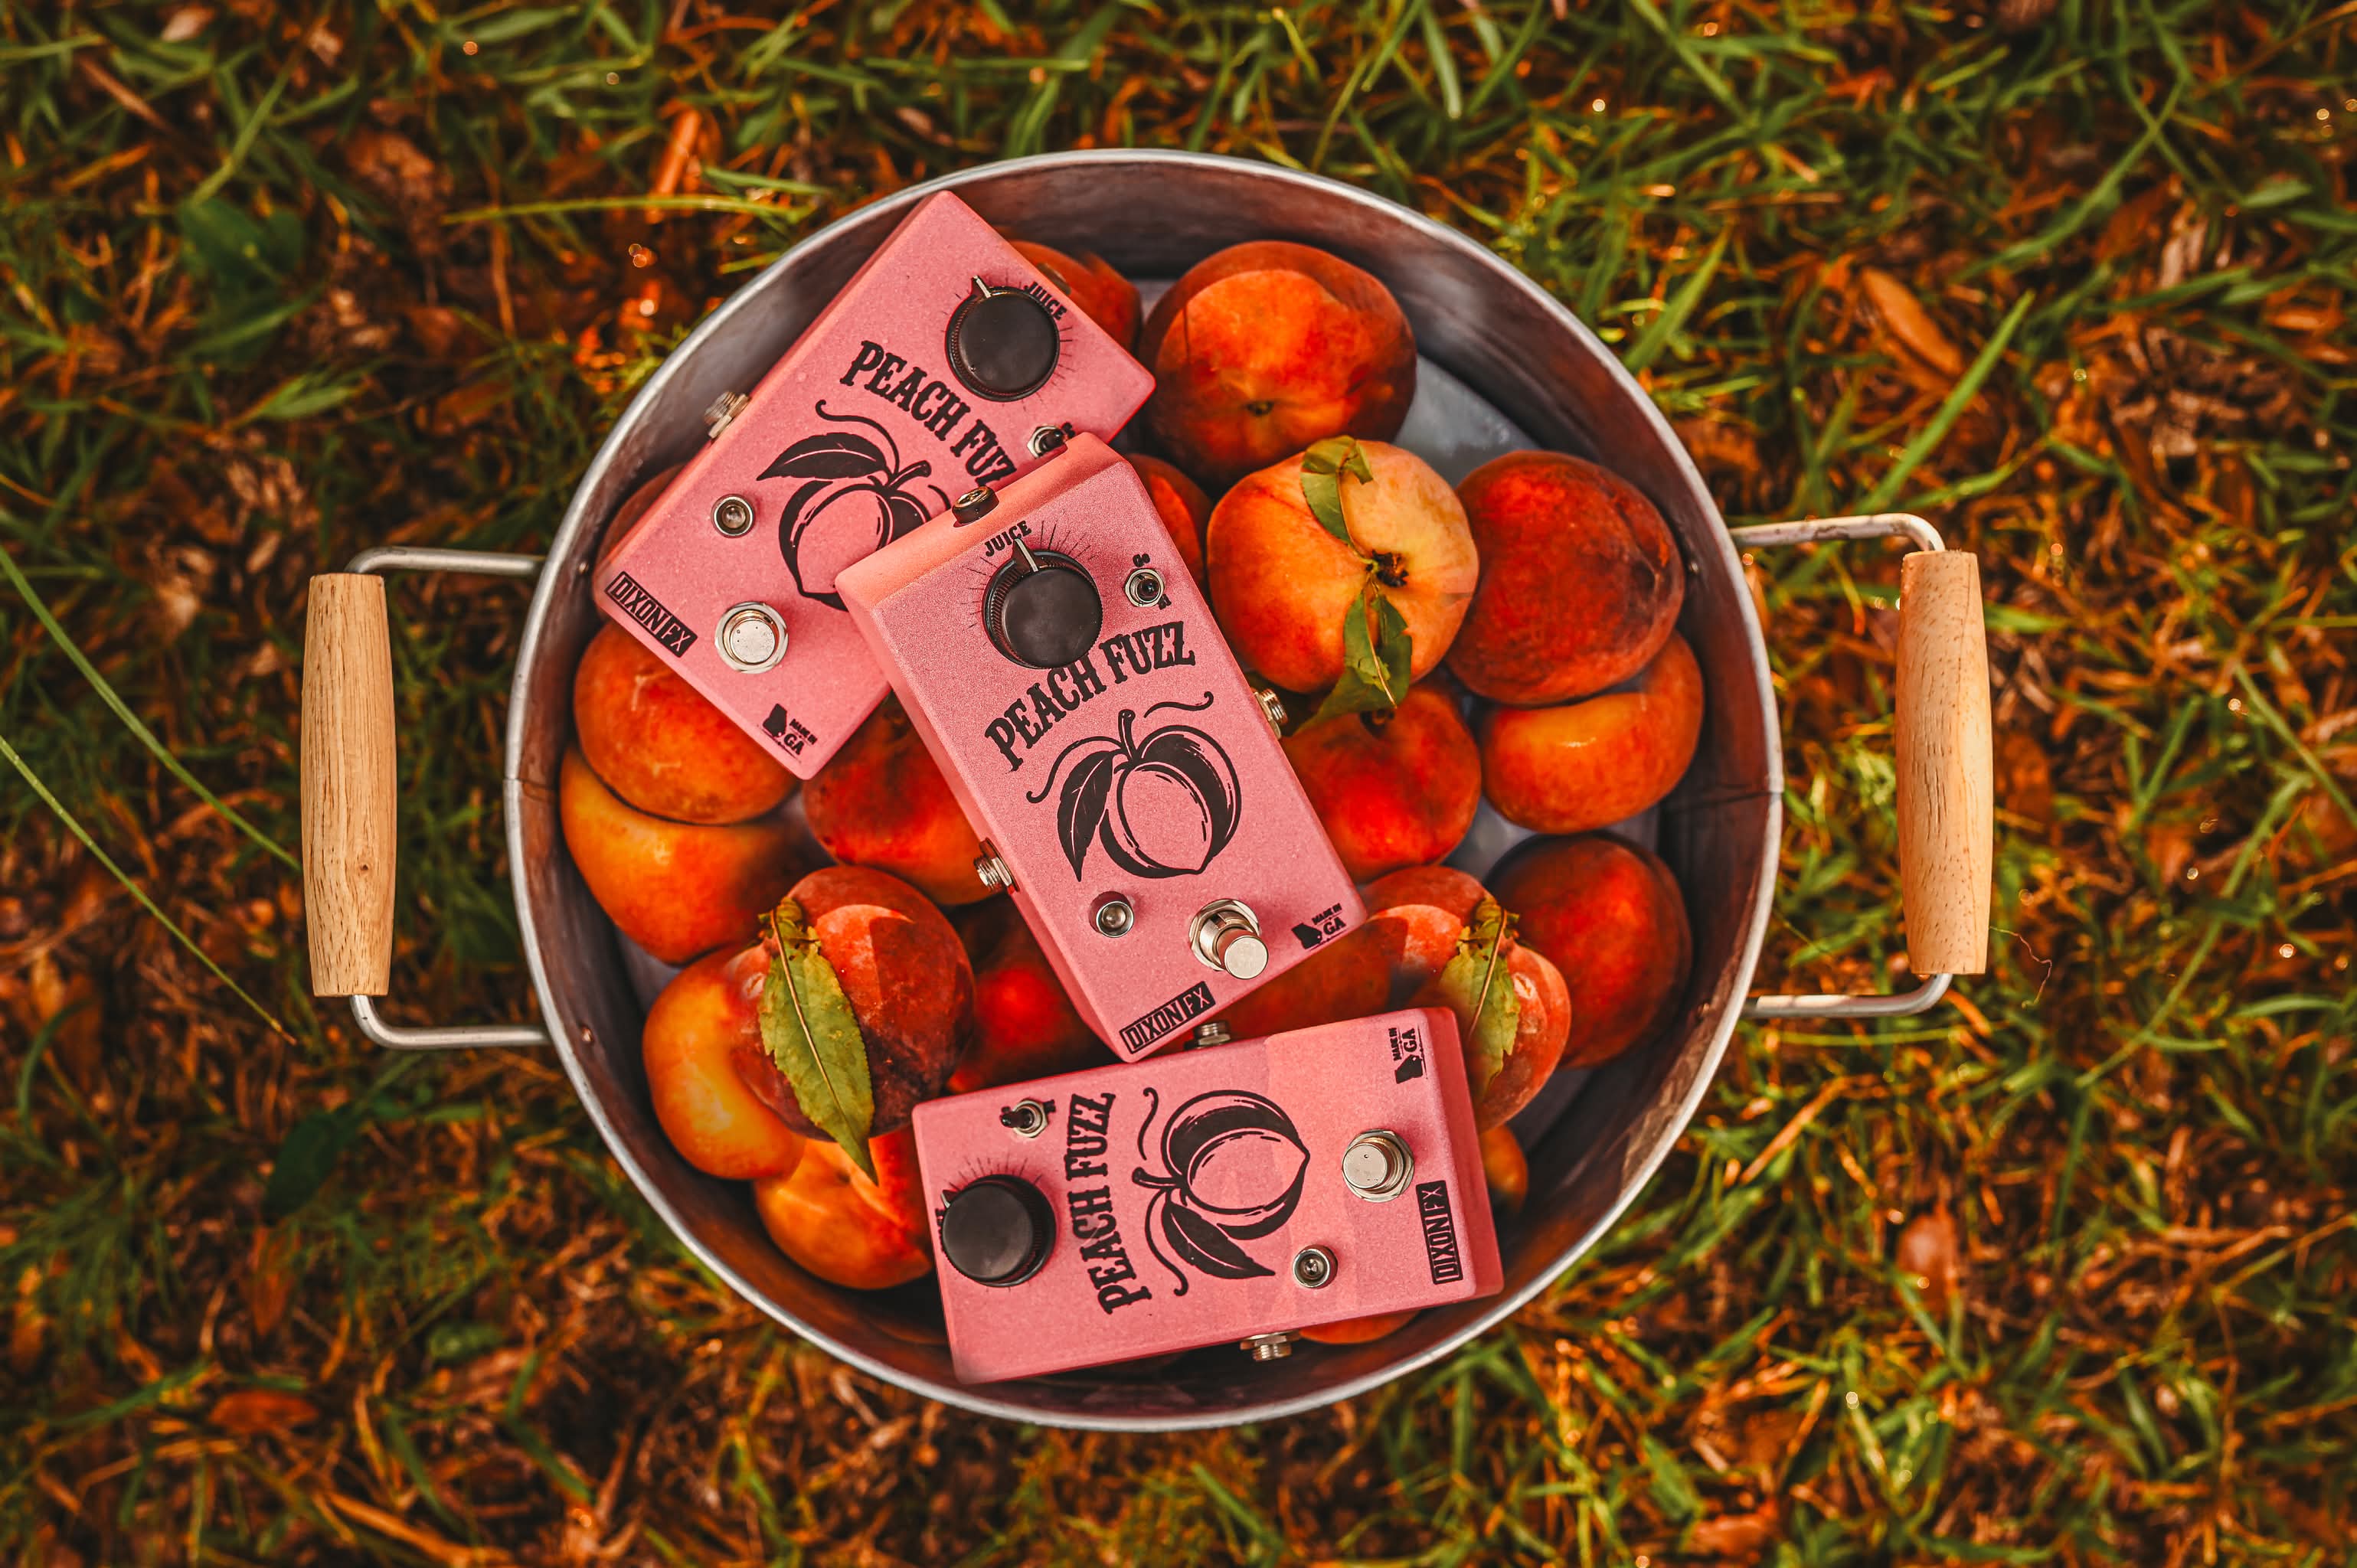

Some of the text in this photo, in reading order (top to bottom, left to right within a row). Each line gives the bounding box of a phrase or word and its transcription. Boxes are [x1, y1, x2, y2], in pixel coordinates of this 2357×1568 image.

[1024, 281, 1067, 321] JUICE
[839, 340, 1018, 488] PEACH FUZ
[984, 520, 1032, 557] JUICE
[609, 575, 691, 652] DIXON FX
[984, 620, 1196, 772] PEACH FUZZ
[783, 733, 804, 756] GA
[1322, 916, 1346, 936] GA
[1124, 987, 1211, 1050] DIXON FX
[1401, 1027, 1417, 1053] GA
[1064, 1093, 1152, 1315] PEACH FUZZ
[1420, 1186, 1460, 1279] DIXON FX
